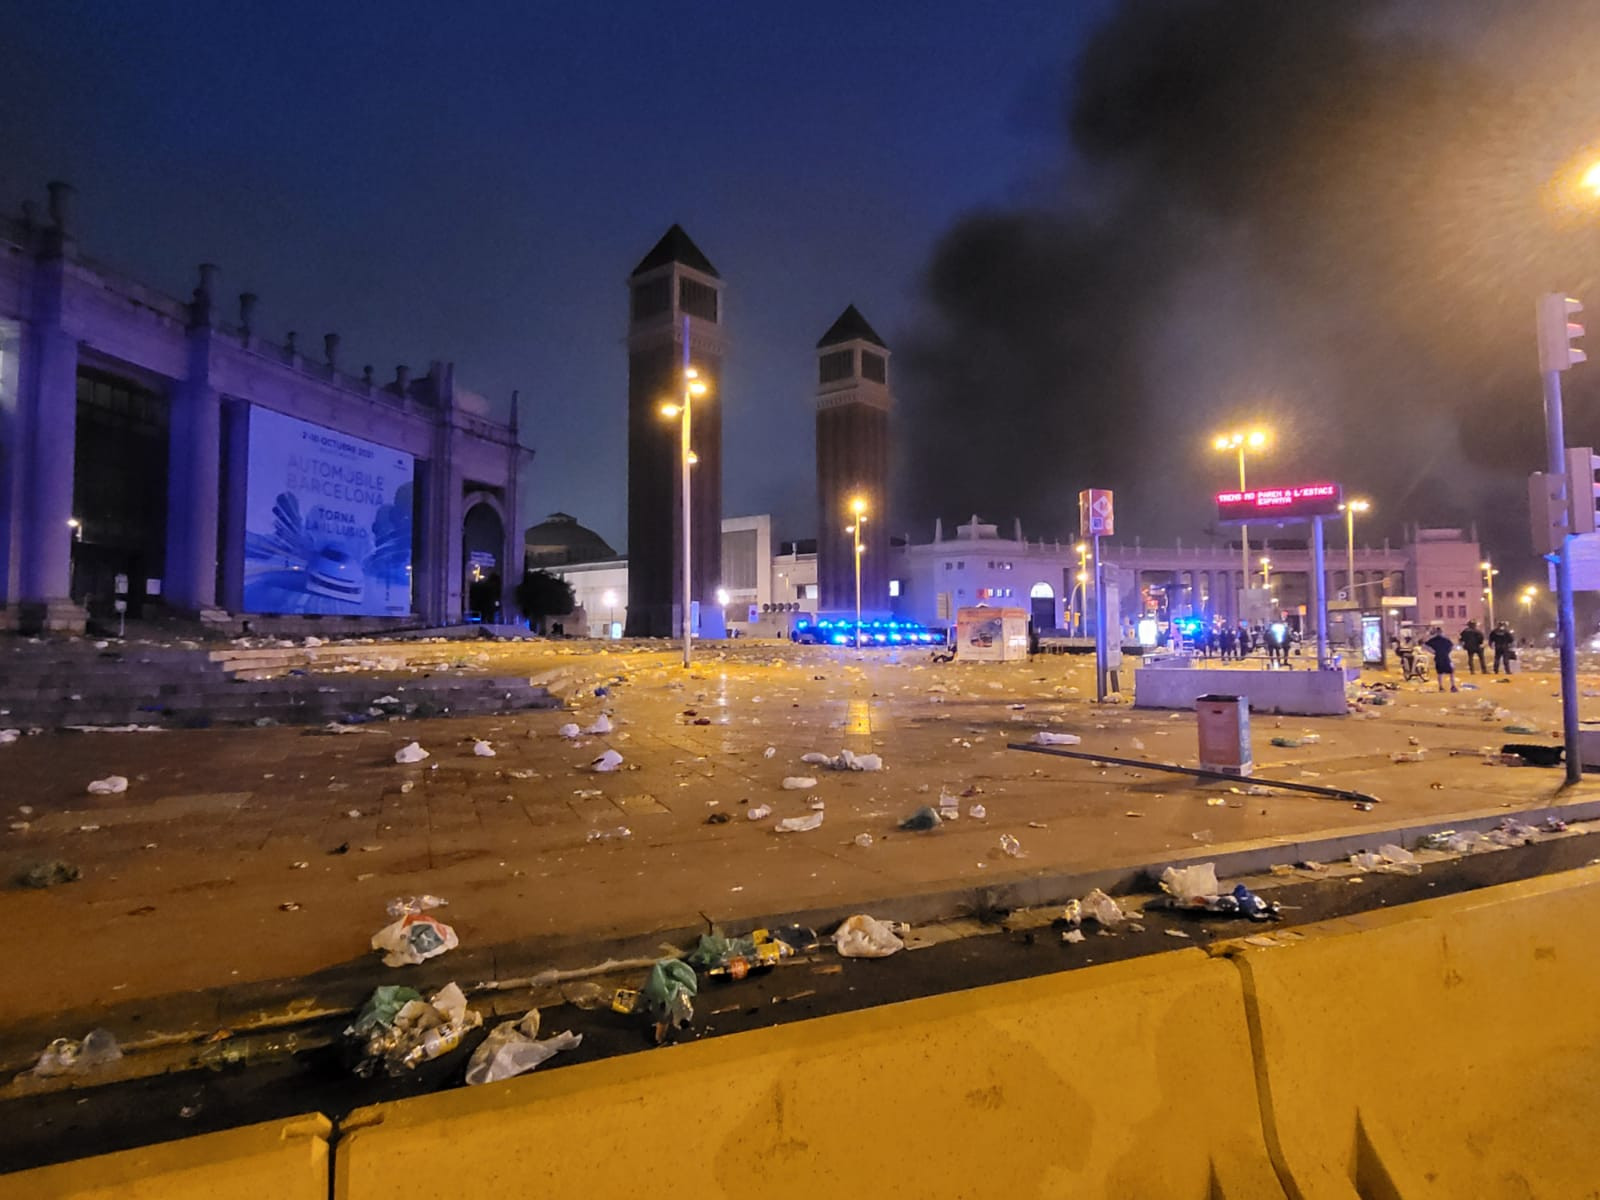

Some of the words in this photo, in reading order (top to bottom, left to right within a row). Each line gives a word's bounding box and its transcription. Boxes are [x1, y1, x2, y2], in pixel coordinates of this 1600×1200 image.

[320, 436, 356, 453] OCTUBRE
[287, 454, 384, 491] AUTOMOBILE
[286, 473, 384, 505] BARCELONA
[318, 508, 355, 523] TORNA
[305, 519, 319, 530] LA
